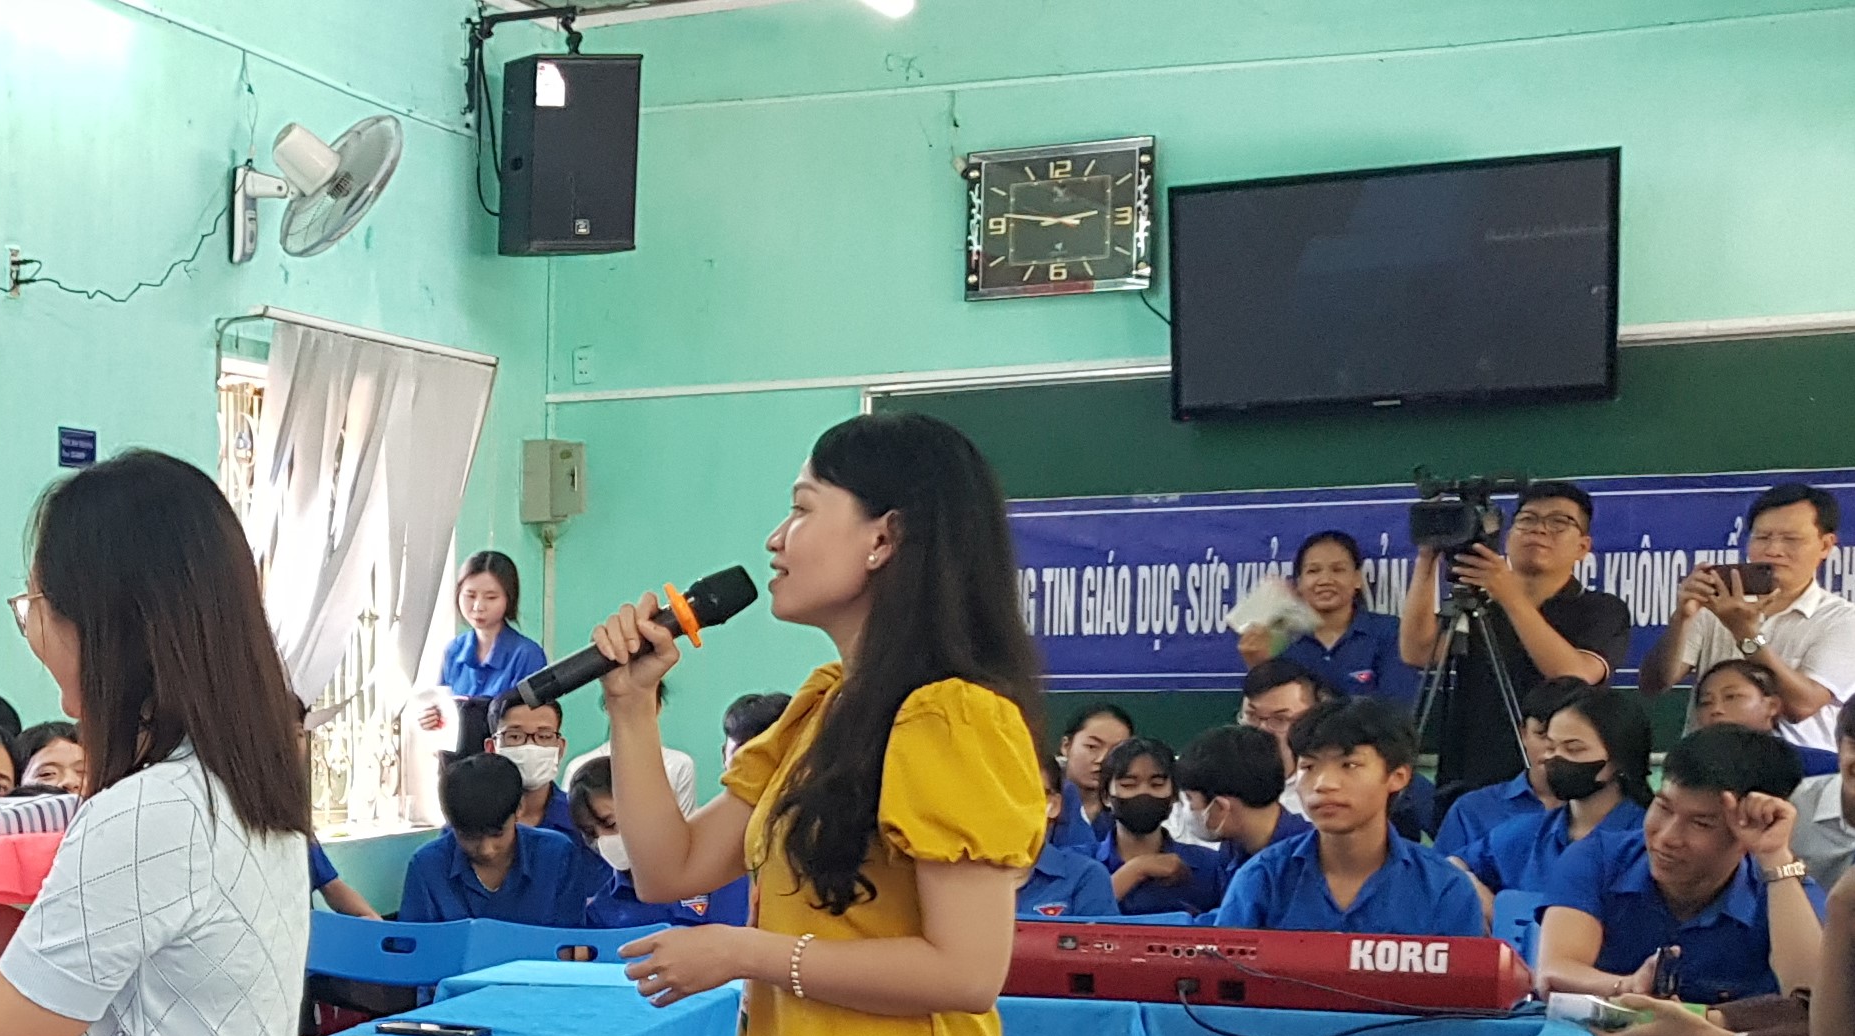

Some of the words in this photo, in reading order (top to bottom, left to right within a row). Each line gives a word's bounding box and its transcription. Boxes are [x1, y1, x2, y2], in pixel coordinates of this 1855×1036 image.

[1049, 160, 1072, 179] 12
[1114, 206, 1133, 225] 3
[988, 217, 1007, 235] 9
[1049, 263, 1068, 281] 6
[1042, 567, 1076, 636] TIN
[1081, 550, 1130, 637] GIÁO
[1136, 562, 1181, 651] DỤC
[1185, 547, 1230, 635] SỨC
[1362, 532, 1409, 617] SẢN
[1349, 939, 1449, 974] KORG
